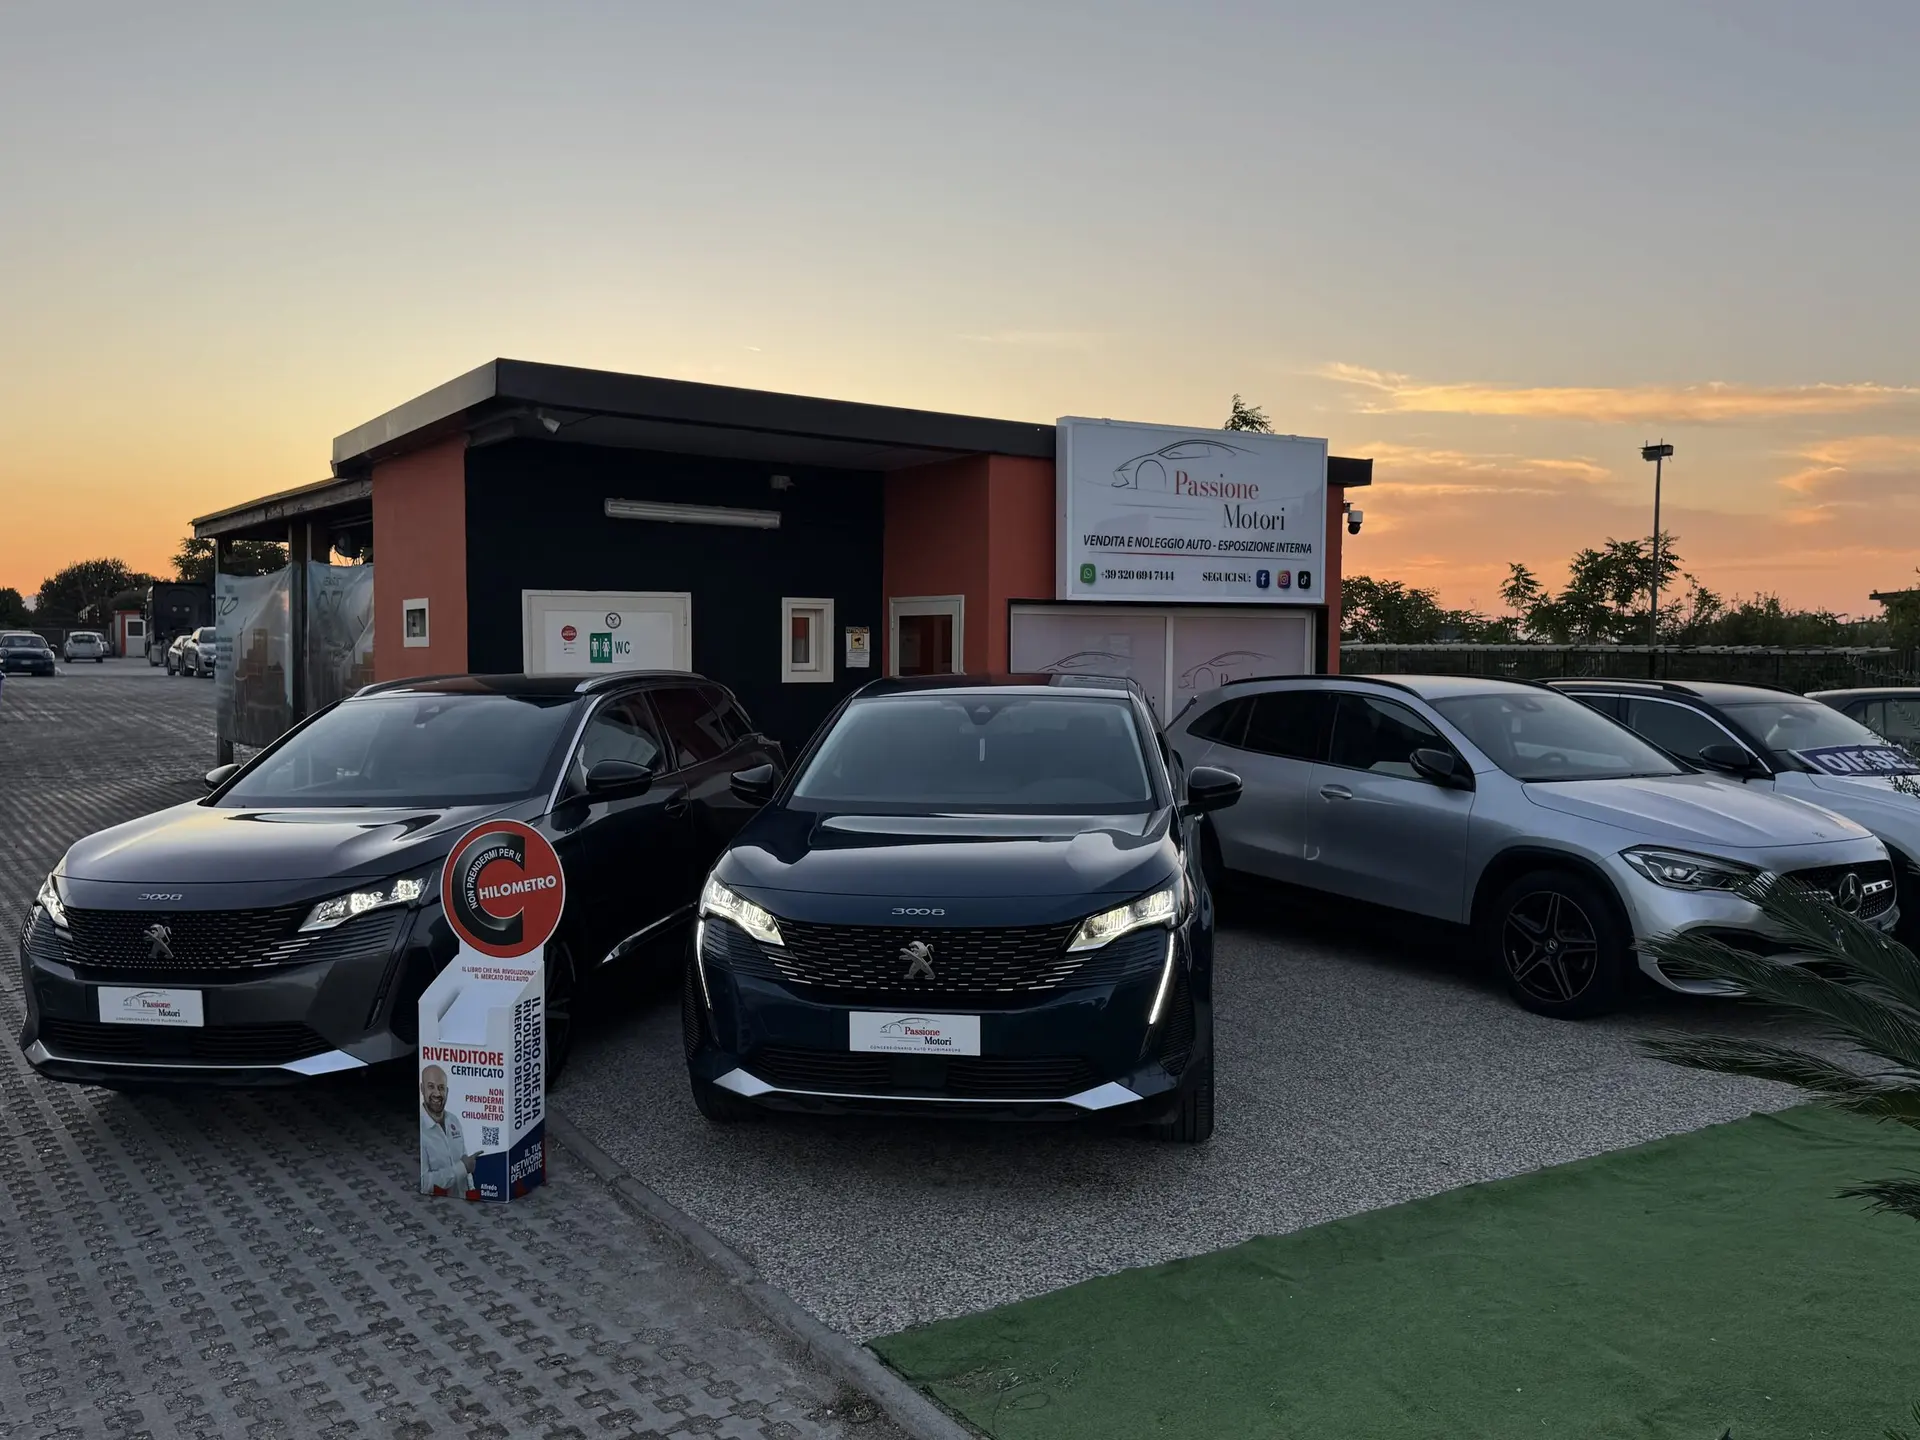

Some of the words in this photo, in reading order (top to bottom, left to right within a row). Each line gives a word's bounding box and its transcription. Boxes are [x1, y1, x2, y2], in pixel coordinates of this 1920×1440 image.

[1175, 469, 1260, 500] Passione
[1223, 503, 1285, 531] Motori
[1083, 534, 1126, 548] VENDITA
[1127, 536, 1134, 547] E
[1135, 536, 1185, 550] NOLEGGIO
[1186, 539, 1212, 551] AUTO
[1218, 539, 1275, 553] ESPOSIZIONE
[1276, 542, 1312, 554] INTERNA
[1100, 569, 1117, 580] +39
[1118, 570, 1135, 580] 320
[1202, 572, 1237, 583] SEGUICI
[1238, 573, 1252, 583] SU:
[615, 641, 631, 655] WC
[1816, 749, 1920, 772] DIESEL
[499, 848, 515, 858] PER
[515, 852, 523, 863] IL
[467, 850, 499, 889] PRENDERMI
[466, 890, 479, 910] NON
[891, 908, 946, 916] 3008
[142, 999, 171, 1009] Passione
[531, 996, 541, 1012] IL
[158, 1008, 181, 1018] Motori
[514, 1003, 523, 1063] MERCATO
[531, 1013, 541, 1059] LIBRO
[904, 1026, 941, 1037] Passione
[924, 1036, 952, 1046] Motori
[422, 1046, 504, 1067] RIVENDITORE
[523, 999, 532, 1109] RIVOLUZIONATO
[450, 1065, 504, 1079] CERTIFICATO
[531, 1062, 541, 1094] CHE
[488, 1088, 504, 1097] NON
[514, 1065, 523, 1130] DELL'AUTO
[465, 1095, 504, 1105] PRENDERMI
[484, 1104, 498, 1113] PER
[531, 1095, 541, 1120] HA
[461, 1111, 504, 1122] CHILOMETRO
[523, 1111, 532, 1126] IL
[524, 1148, 531, 1157] IL
[511, 1150, 542, 1175] NETWORK
